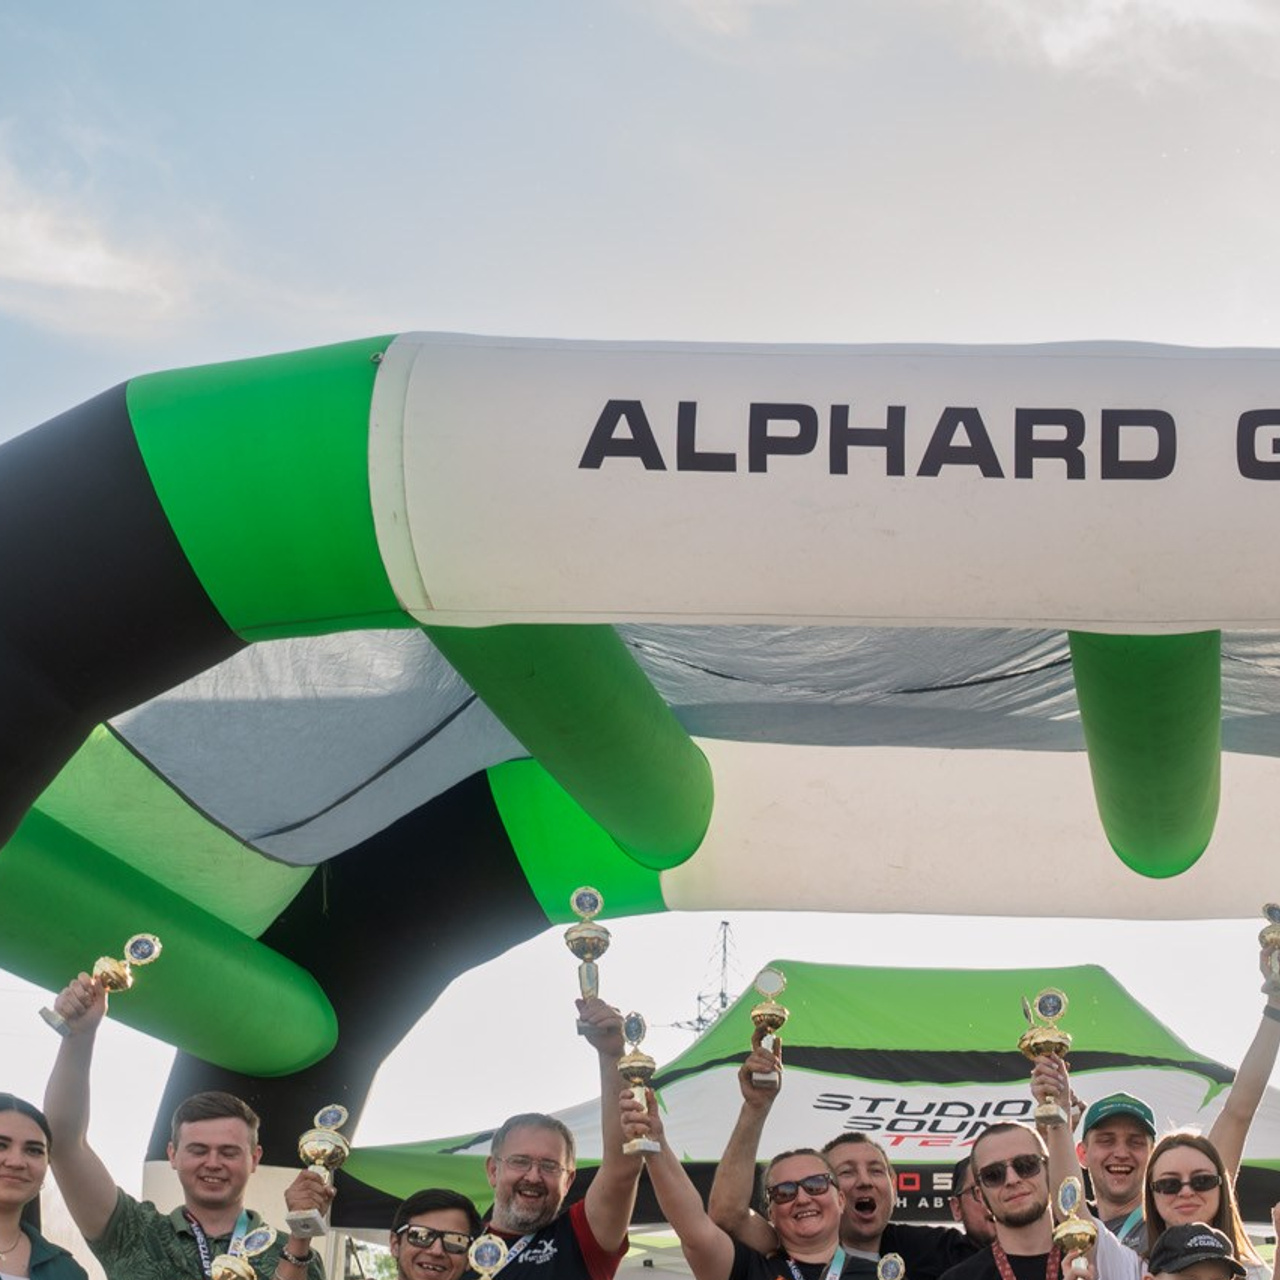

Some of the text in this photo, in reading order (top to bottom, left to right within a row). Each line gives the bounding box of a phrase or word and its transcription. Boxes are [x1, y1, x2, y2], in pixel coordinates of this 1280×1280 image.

[578, 398, 1177, 481] ALPHARD
[812, 1092, 1033, 1119] STUDIO
[843, 1115, 1035, 1140] SOUN
